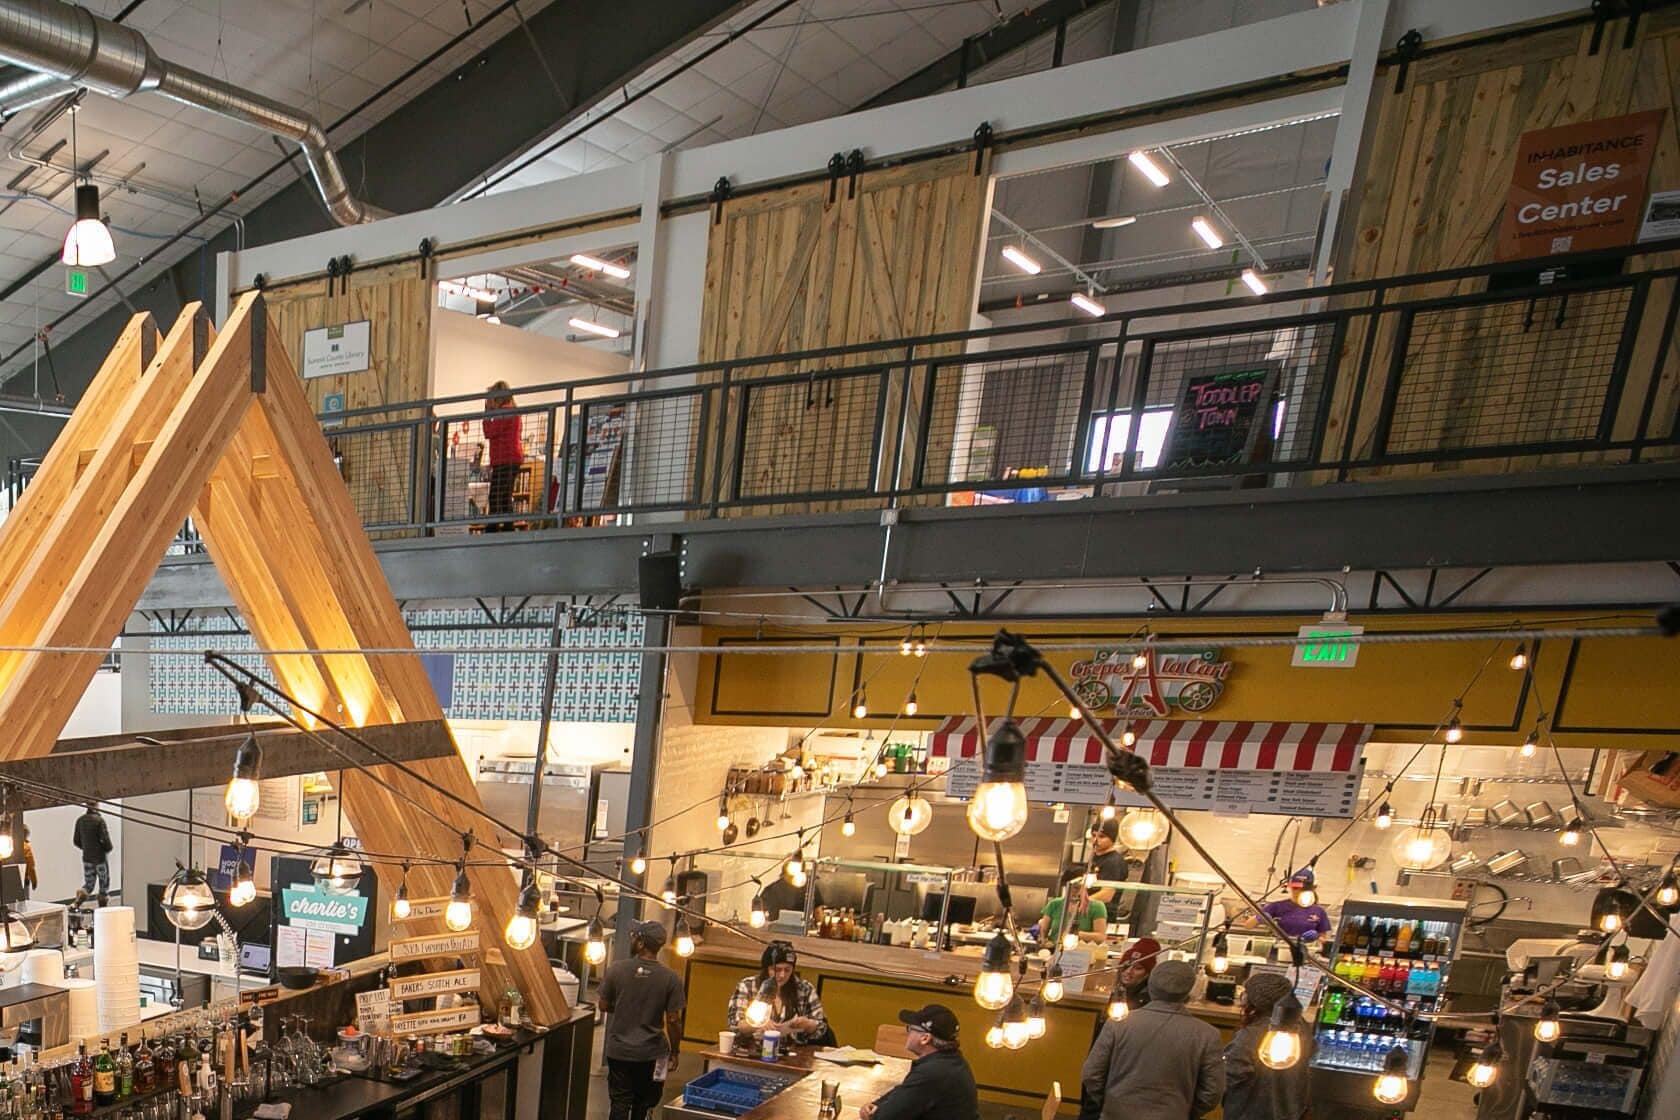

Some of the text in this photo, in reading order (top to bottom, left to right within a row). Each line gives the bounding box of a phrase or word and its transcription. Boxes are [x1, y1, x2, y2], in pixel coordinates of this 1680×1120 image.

[1527, 134, 1645, 163] INHABITANCE
[1536, 161, 1622, 190] Sales
[1517, 193, 1628, 224] Center
[1189, 381, 1263, 406] TODDLER
[290, 897, 359, 920] charlie's
